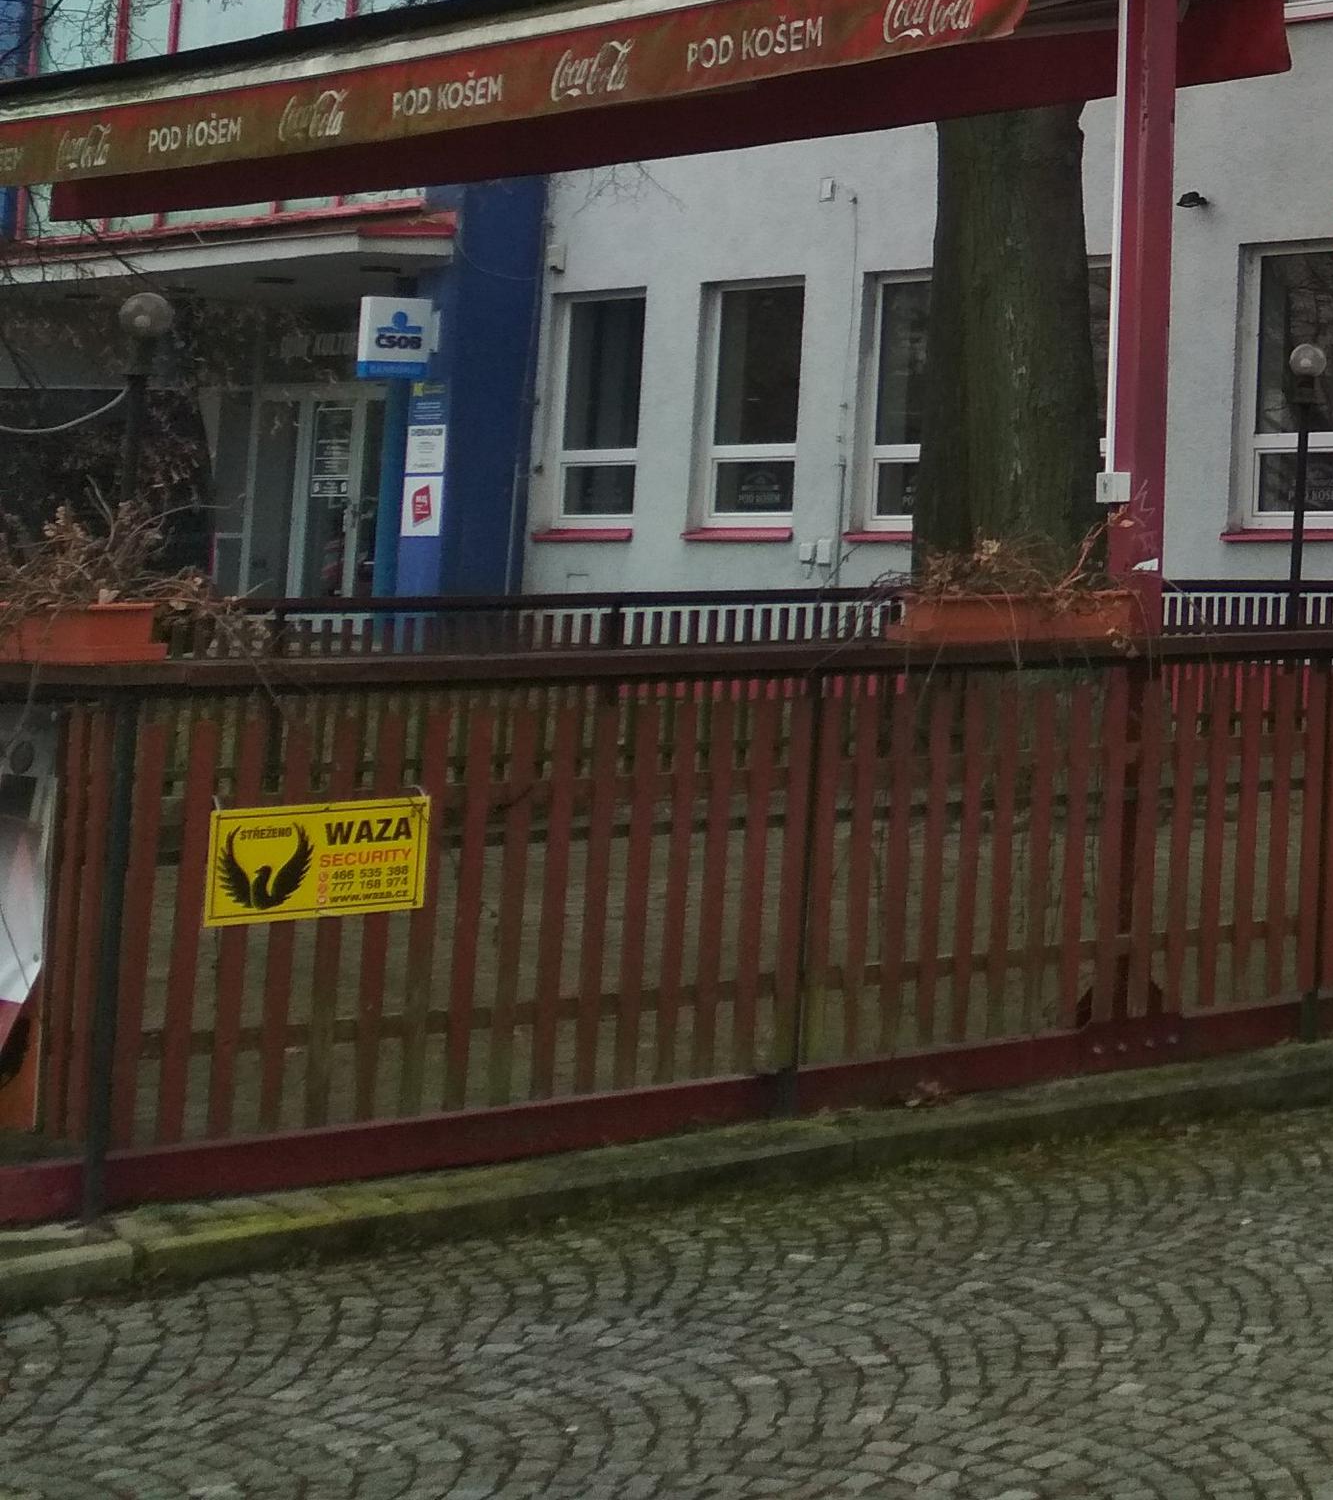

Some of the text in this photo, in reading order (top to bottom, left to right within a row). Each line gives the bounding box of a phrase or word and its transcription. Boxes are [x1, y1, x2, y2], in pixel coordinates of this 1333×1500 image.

[687, 15, 824, 71] POD KOŠEM
[392, 70, 504, 118] POD KOŠEM
[148, 125, 183, 153] POD
[375, 333, 422, 350] ČSOB
[240, 826, 293, 841] STŘEŽENO
[324, 816, 412, 846] WAZA
[319, 847, 412, 868] SECURITY
[359, 867, 382, 879] 535
[331, 881, 354, 892] 777
[386, 877, 409, 888] 974
